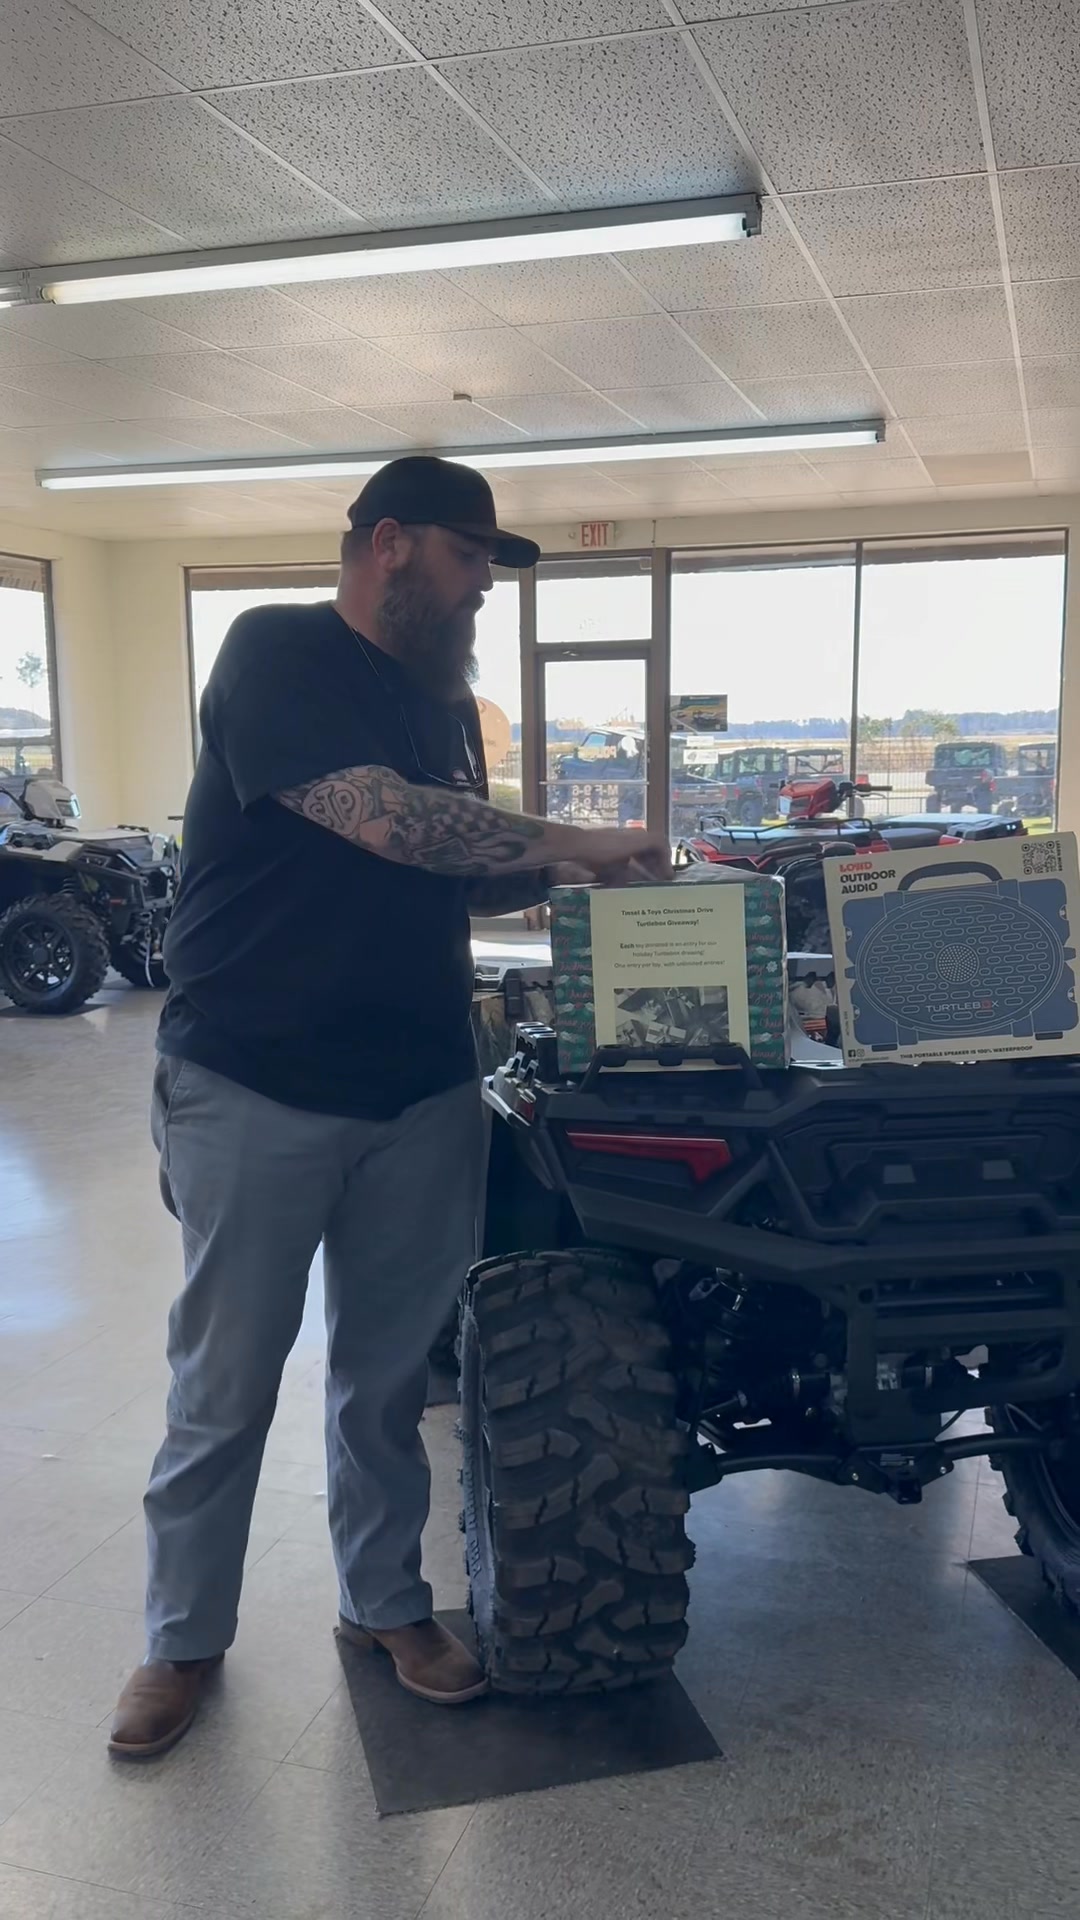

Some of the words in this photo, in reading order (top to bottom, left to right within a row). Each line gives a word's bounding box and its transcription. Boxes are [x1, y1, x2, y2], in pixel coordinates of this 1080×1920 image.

[581, 523, 609, 547] EXIT
[840, 869, 896, 883] OUTDOOR
[841, 881, 878, 894] AUDIO
[647, 908, 662, 916] Toys
[662, 907, 696, 915] Christmas
[636, 920, 667, 928] Turtlebox
[667, 919, 700, 927] Giveaway!
[619, 942, 635, 950] Each
[635, 942, 645, 950] toy
[682, 940, 698, 948] entry
[925, 1000, 1000, 1013] TURTLEBOX
[993, 1045, 1034, 1053] WATERPROOF
